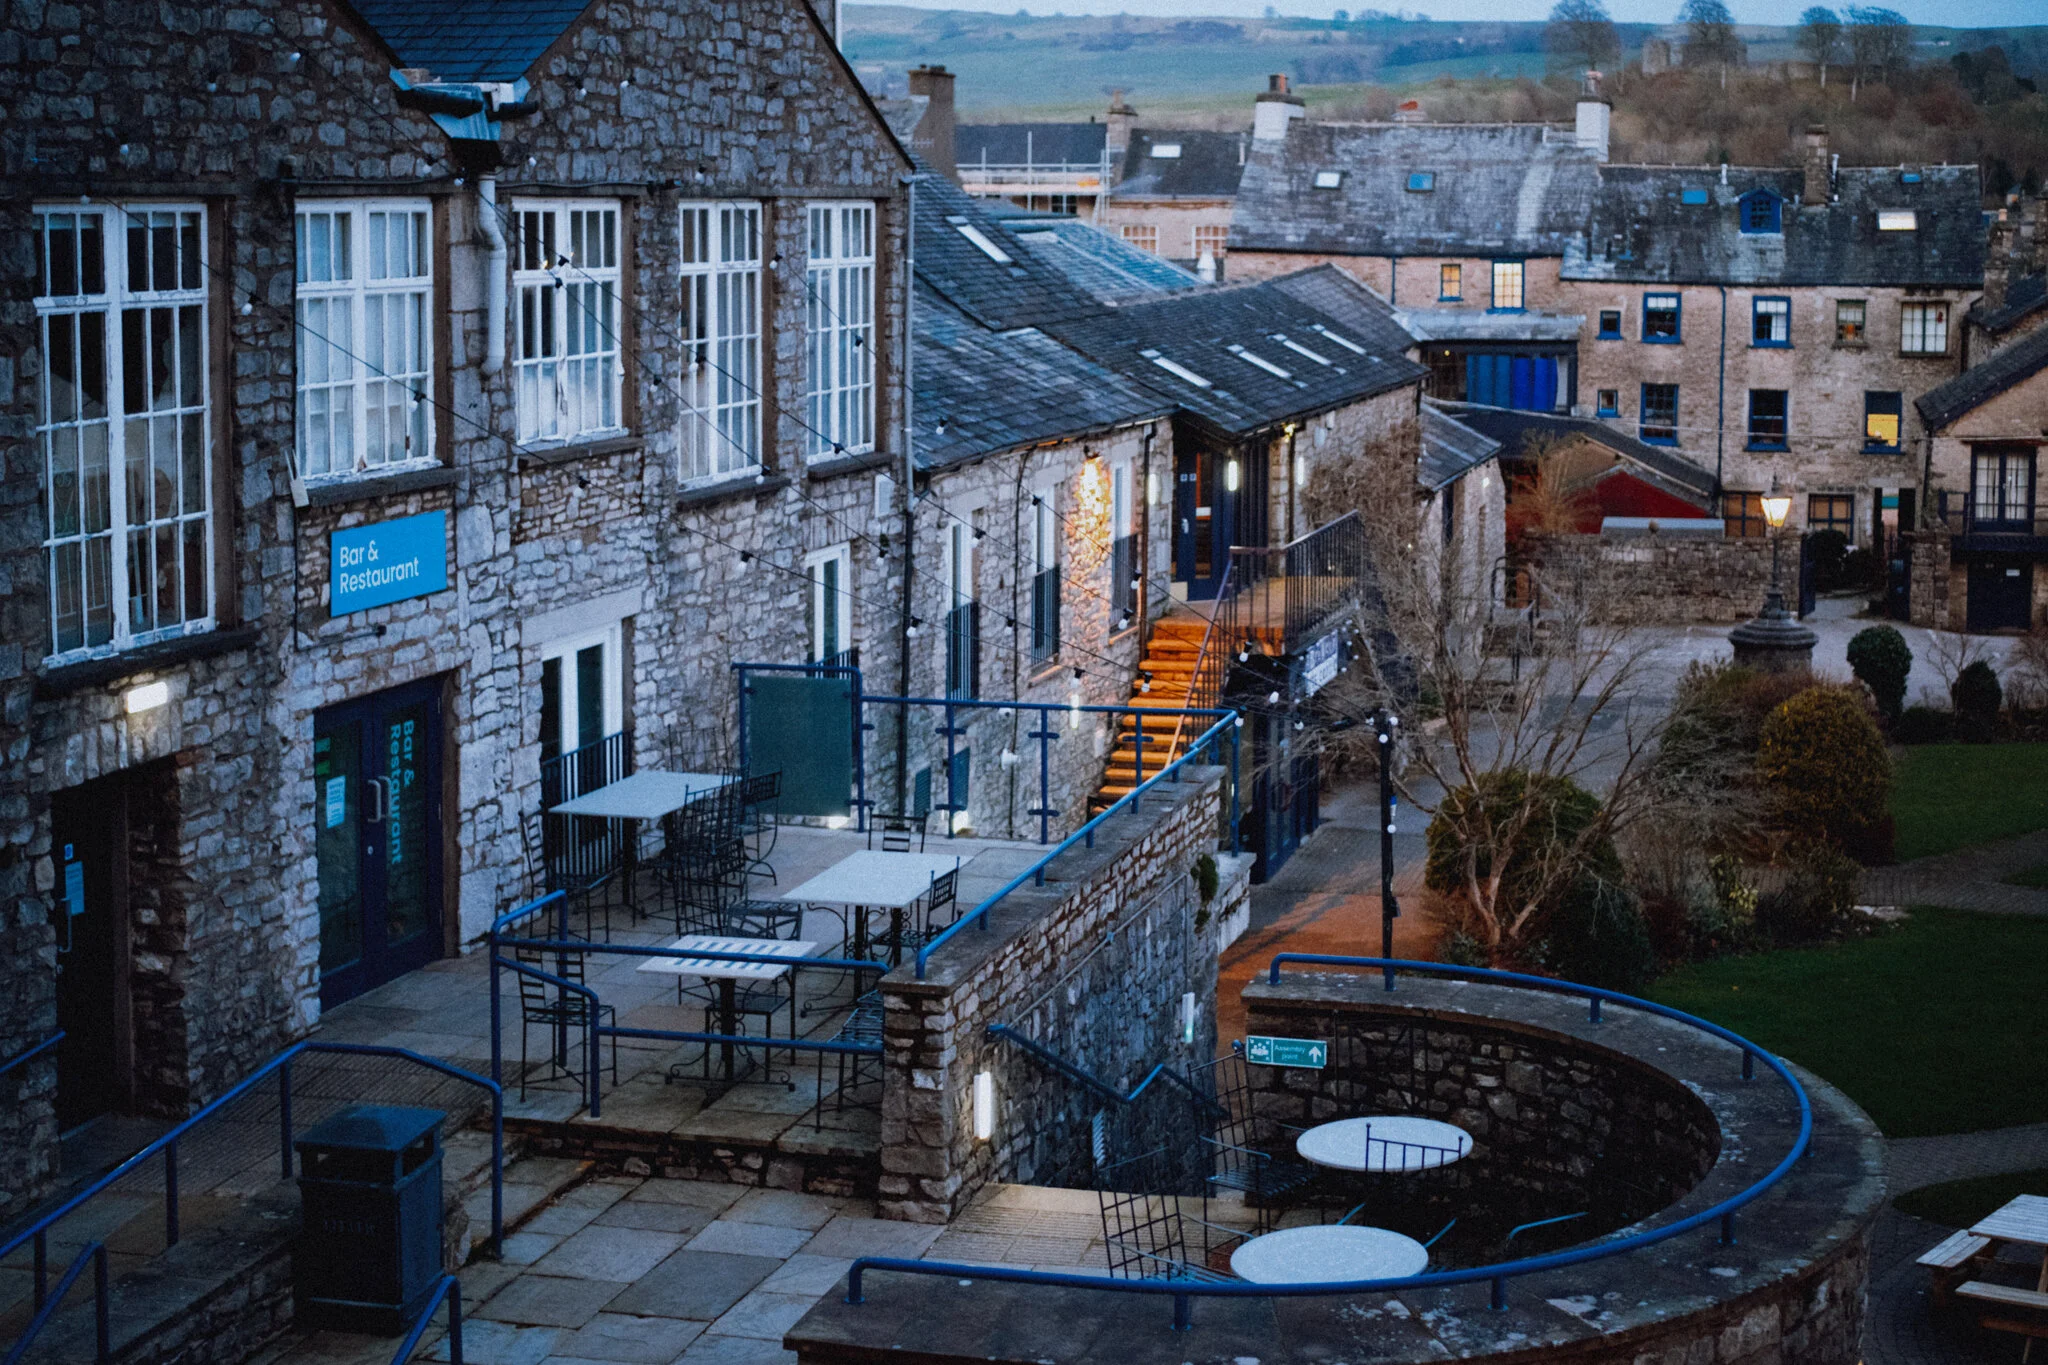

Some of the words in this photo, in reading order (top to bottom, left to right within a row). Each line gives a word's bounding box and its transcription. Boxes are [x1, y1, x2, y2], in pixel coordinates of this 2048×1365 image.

[340, 546, 365, 568] Bar
[367, 540, 379, 562] &
[340, 556, 419, 594] Restaurant
[403, 720, 415, 761] Bar
[390, 723, 402, 864] Restaurant
[404, 769, 415, 787] &
[1274, 1044, 1305, 1054] Assembly
